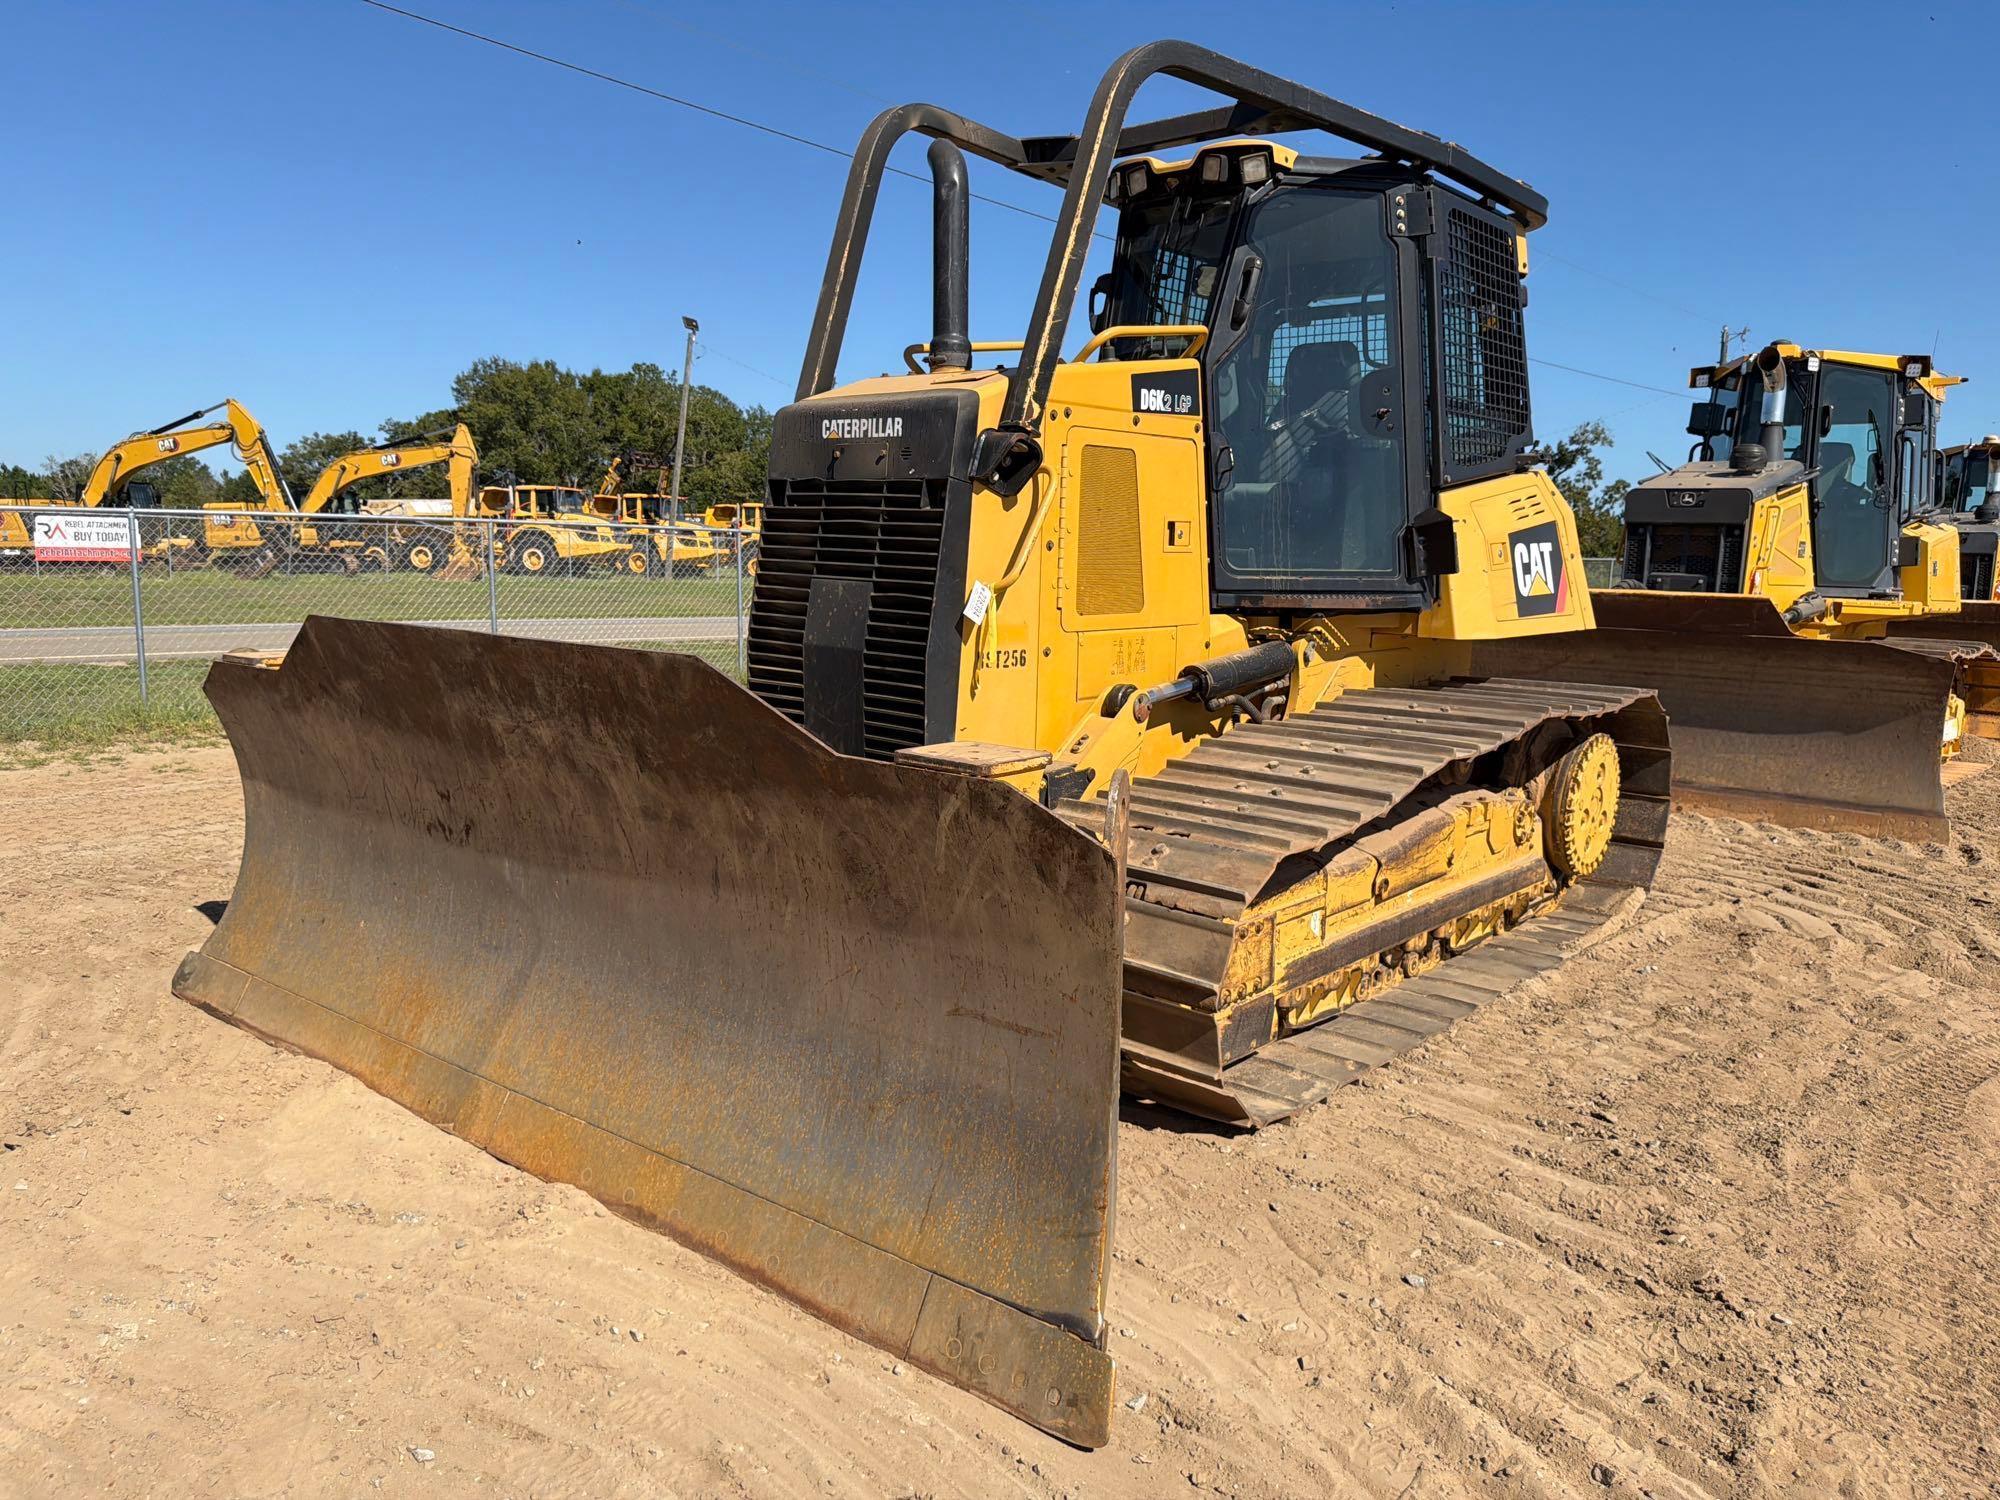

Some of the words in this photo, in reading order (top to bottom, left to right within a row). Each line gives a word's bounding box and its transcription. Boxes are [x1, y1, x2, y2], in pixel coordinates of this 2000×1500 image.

[1174, 394, 1192, 413] LGP
[822, 417, 902, 439] CATERPILLAR
[158, 438, 174, 452] CAT
[381, 454, 397, 466] CAT
[64, 520, 84, 528] REBEL
[74, 531, 92, 541] BUY
[96, 532, 128, 542] TODAY!
[1514, 542, 1555, 597] CAT
